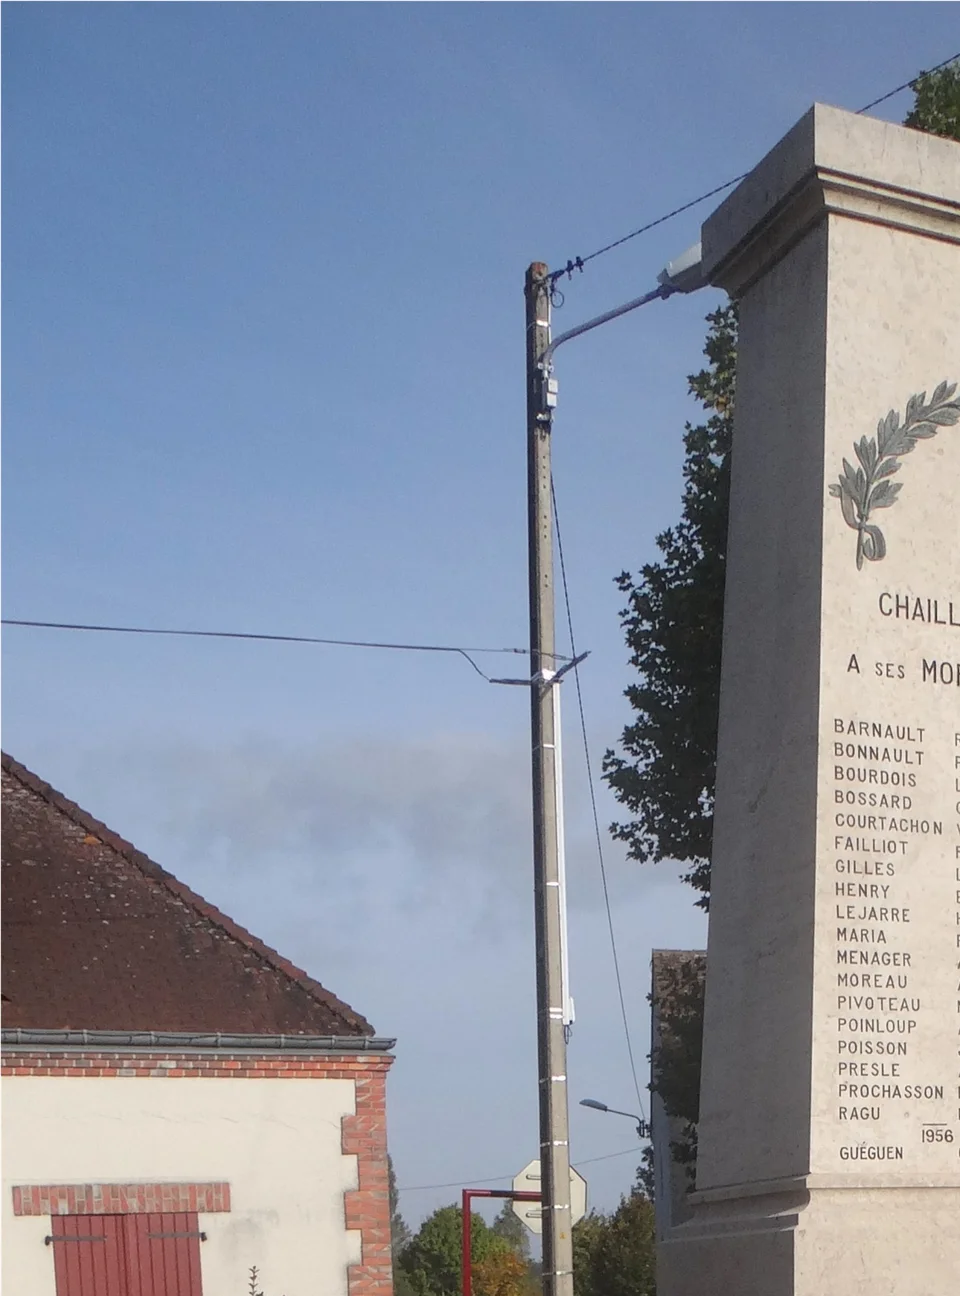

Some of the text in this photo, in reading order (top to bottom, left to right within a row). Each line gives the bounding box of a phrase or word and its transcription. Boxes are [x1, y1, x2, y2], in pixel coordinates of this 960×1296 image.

[847, 654, 860, 674] A
[875, 662, 905, 679] SES
[834, 718, 926, 743] BARNAULT
[834, 743, 924, 765] BONNAULT
[834, 766, 917, 787] BOURDOIS
[834, 790, 912, 810] BOSSARD
[835, 814, 943, 835] COURTACHON
[834, 837, 909, 854] FAILLIOT
[835, 860, 895, 876] GILLES
[835, 883, 890, 899] HENRY
[836, 905, 910, 923] LEJARRE
[836, 928, 887, 944] MARIA
[837, 951, 911, 967] MENAGER
[837, 974, 908, 989] MOREAU
[837, 997, 920, 1011] PIVOTEAU
[838, 1018, 917, 1034] POINLOUP
[838, 1041, 907, 1055] POISSON
[838, 1063, 900, 1076] PRESLE
[838, 1085, 944, 1099] PROCHASSON
[839, 1107, 880, 1120] RAGU
[921, 1129, 954, 1143] 1956
